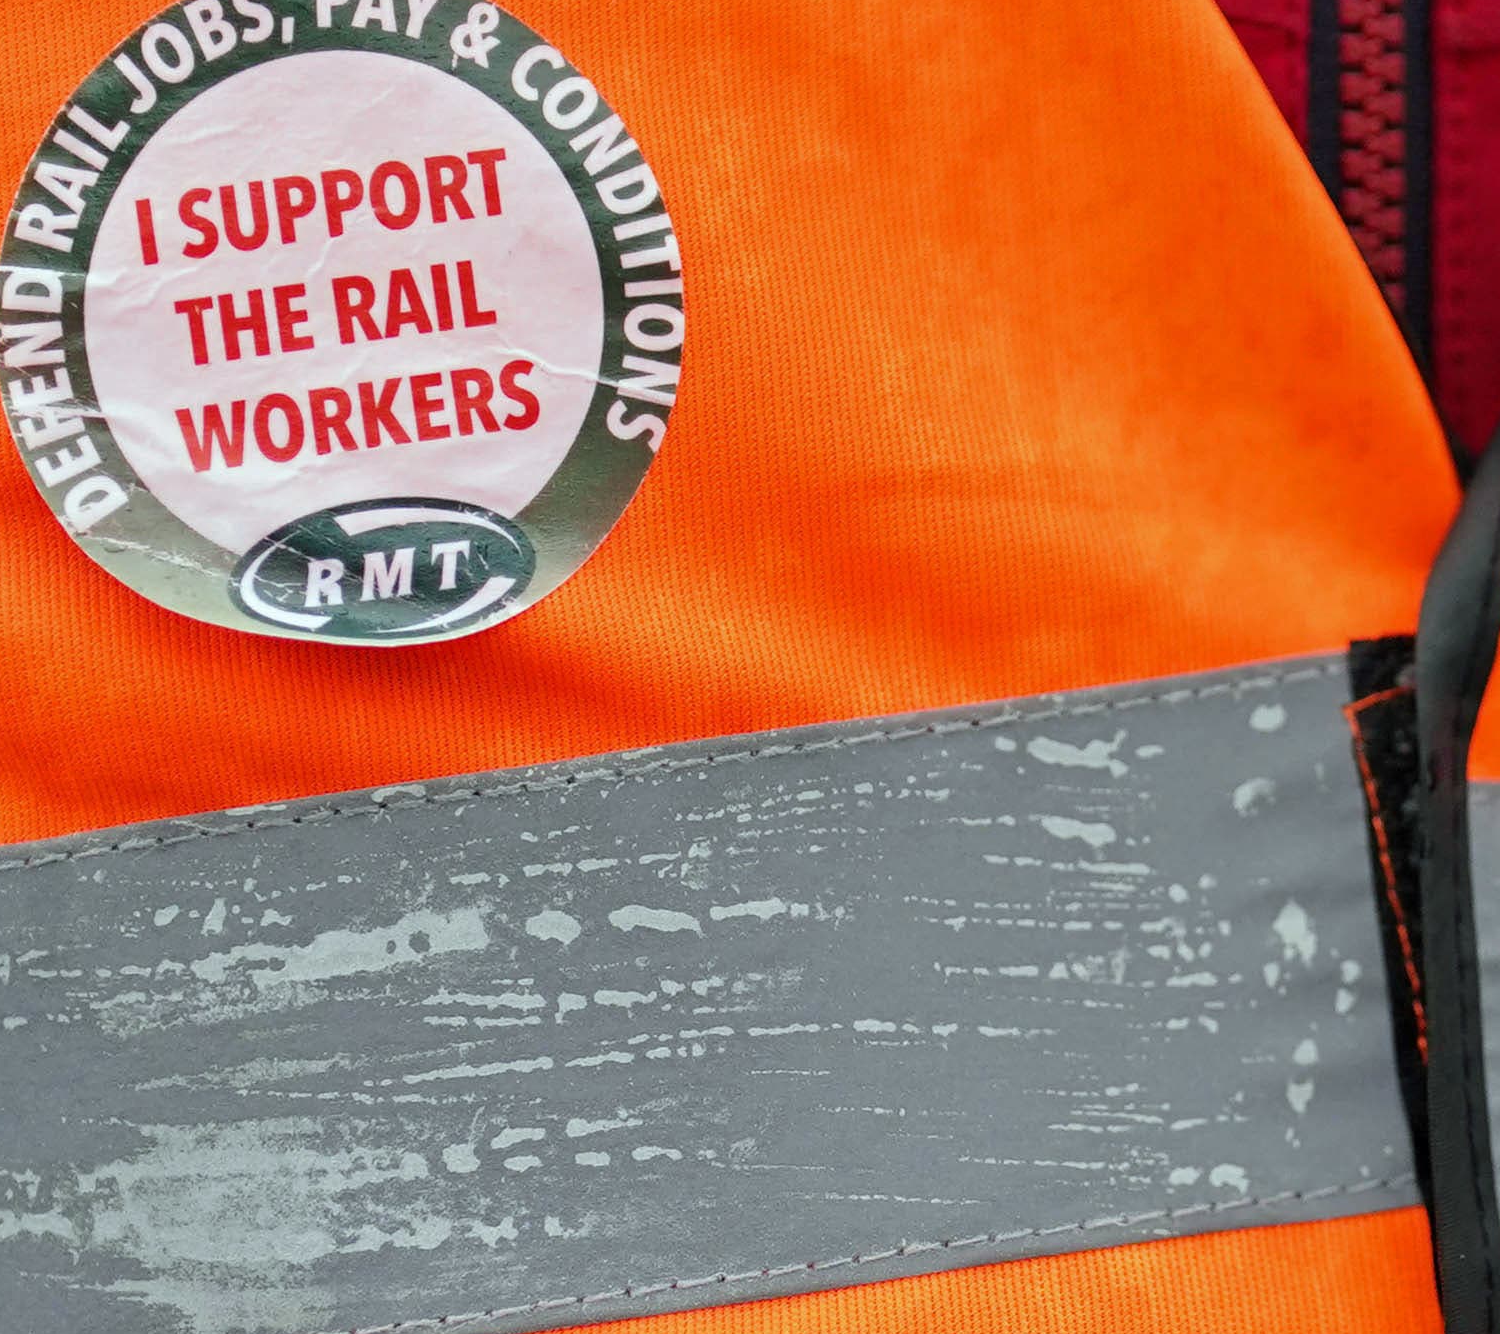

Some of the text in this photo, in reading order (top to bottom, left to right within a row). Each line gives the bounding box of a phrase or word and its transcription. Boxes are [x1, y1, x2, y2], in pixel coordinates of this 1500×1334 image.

[449, 2, 501, 69] &
[15, 104, 129, 253] RAIL
[135, 147, 508, 266] I SUPPORT
[509, 44, 685, 454] CONDITIONS
[174, 259, 498, 366] THE RAIL
[1, 268, 130, 533] DEFEND
[174, 359, 542, 473] WORKERS
[303, 539, 473, 609] RMT
